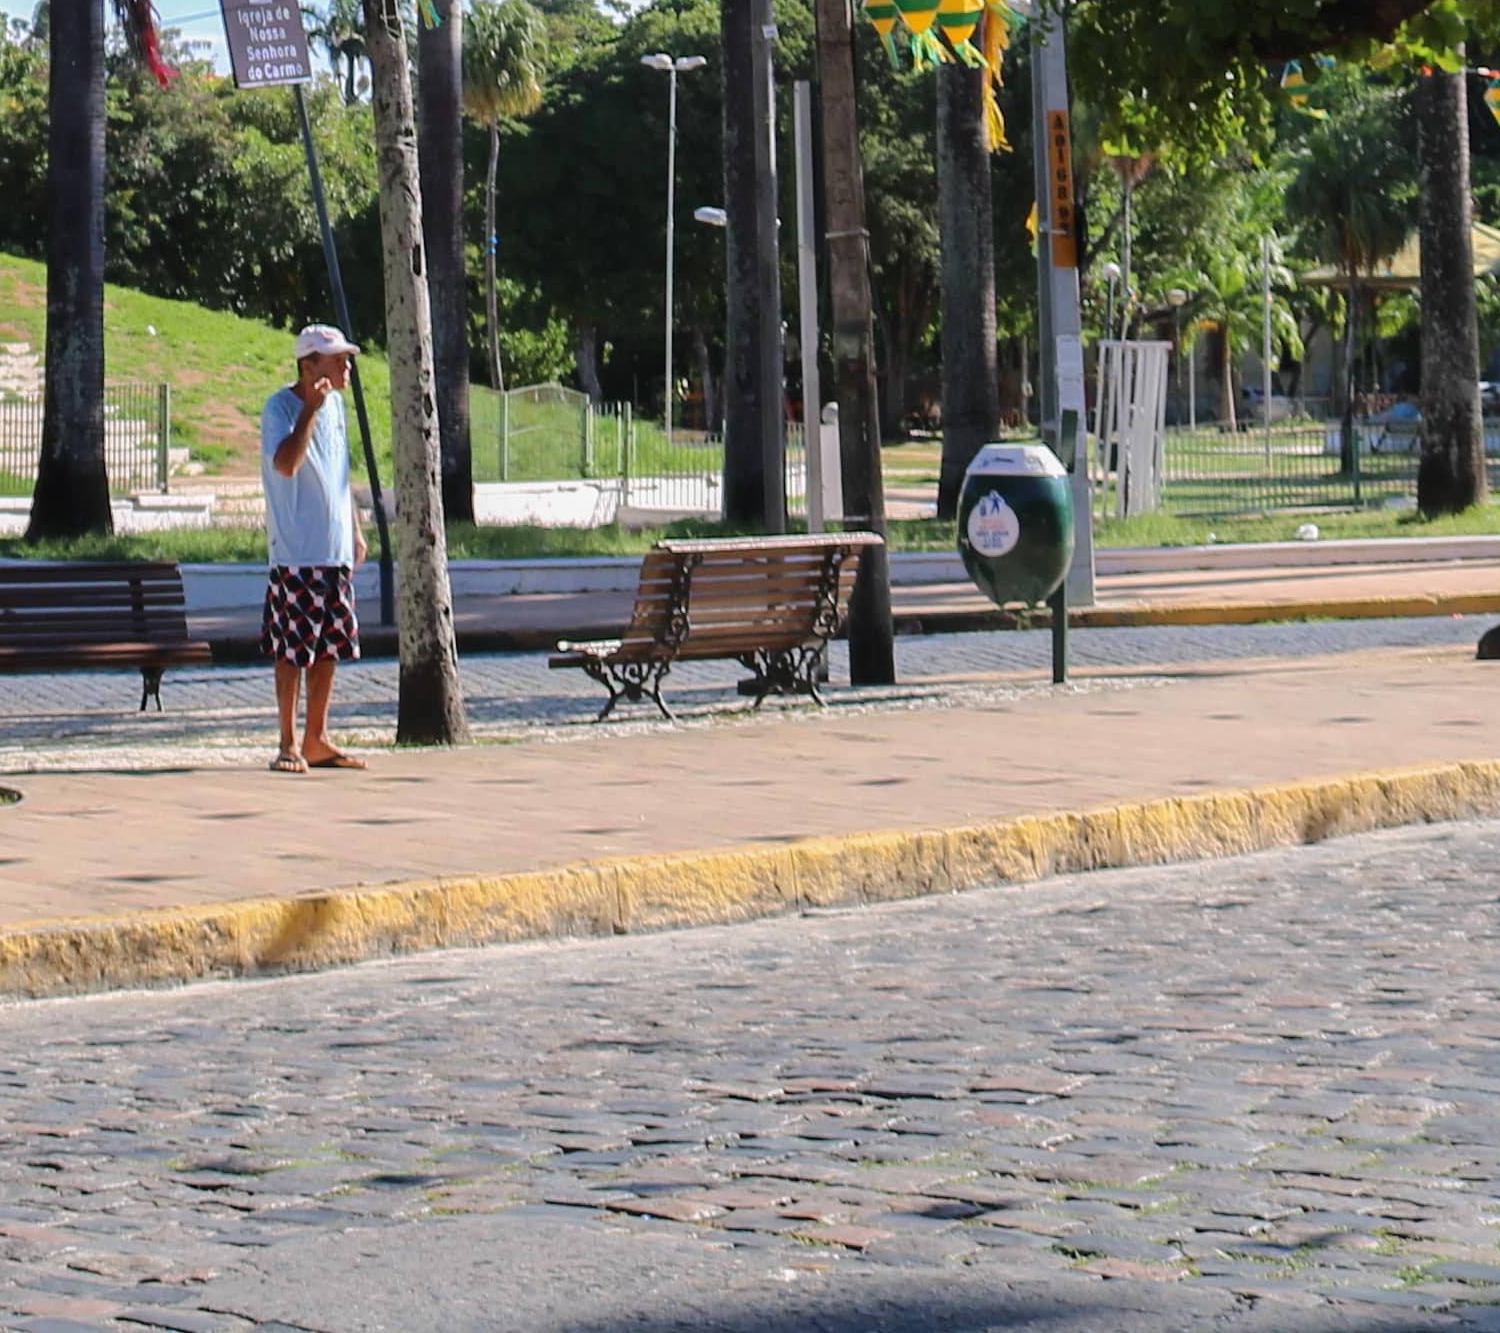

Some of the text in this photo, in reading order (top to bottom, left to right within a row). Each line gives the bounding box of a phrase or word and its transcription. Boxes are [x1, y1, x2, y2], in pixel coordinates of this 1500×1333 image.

[237, 5, 290, 27] Igreja de
[249, 26, 286, 43] Nossa
[246, 44, 297, 61] Senhora
[247, 63, 303, 80] do Carmo
